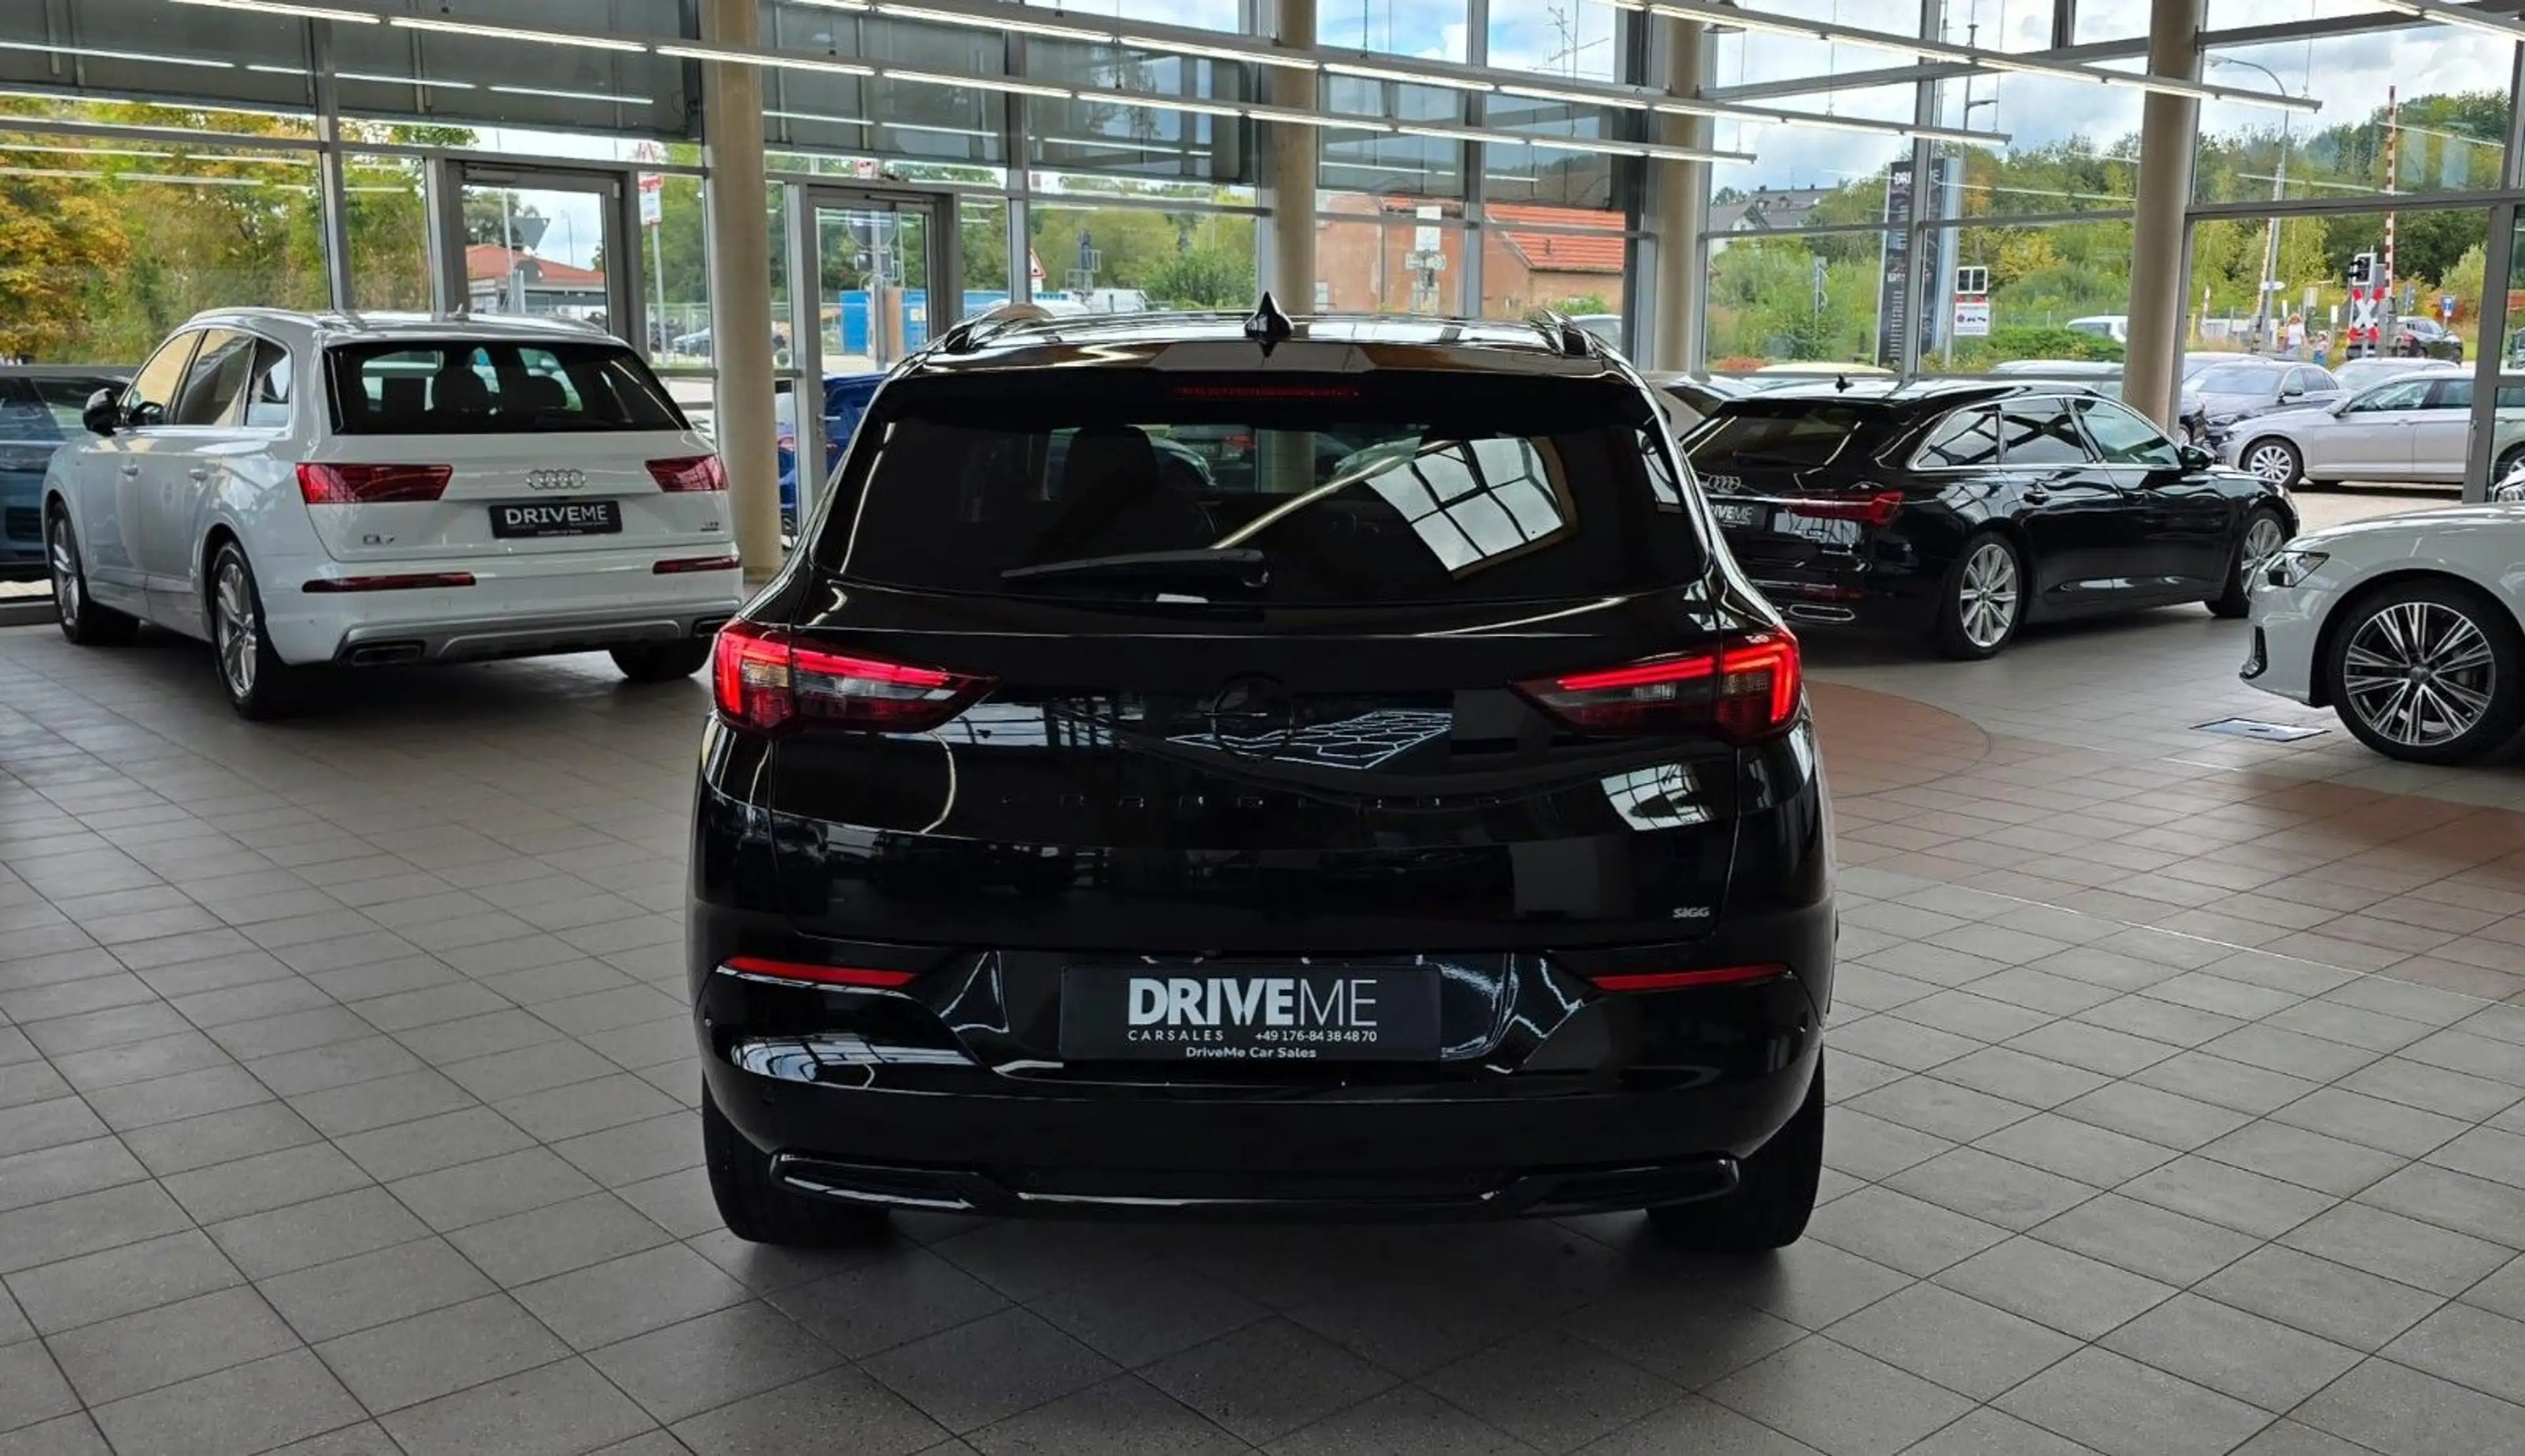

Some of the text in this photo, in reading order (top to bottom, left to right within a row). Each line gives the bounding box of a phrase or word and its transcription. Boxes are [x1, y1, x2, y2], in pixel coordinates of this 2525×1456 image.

[506, 505, 608, 525] DRIVEME
[1128, 978, 1377, 1026] DRIVEME
[1128, 1030, 1224, 1041] CARSALES
[1255, 1030, 1279, 1041] +49
[1186, 1046, 1317, 1058] DriveMe Car Sales
